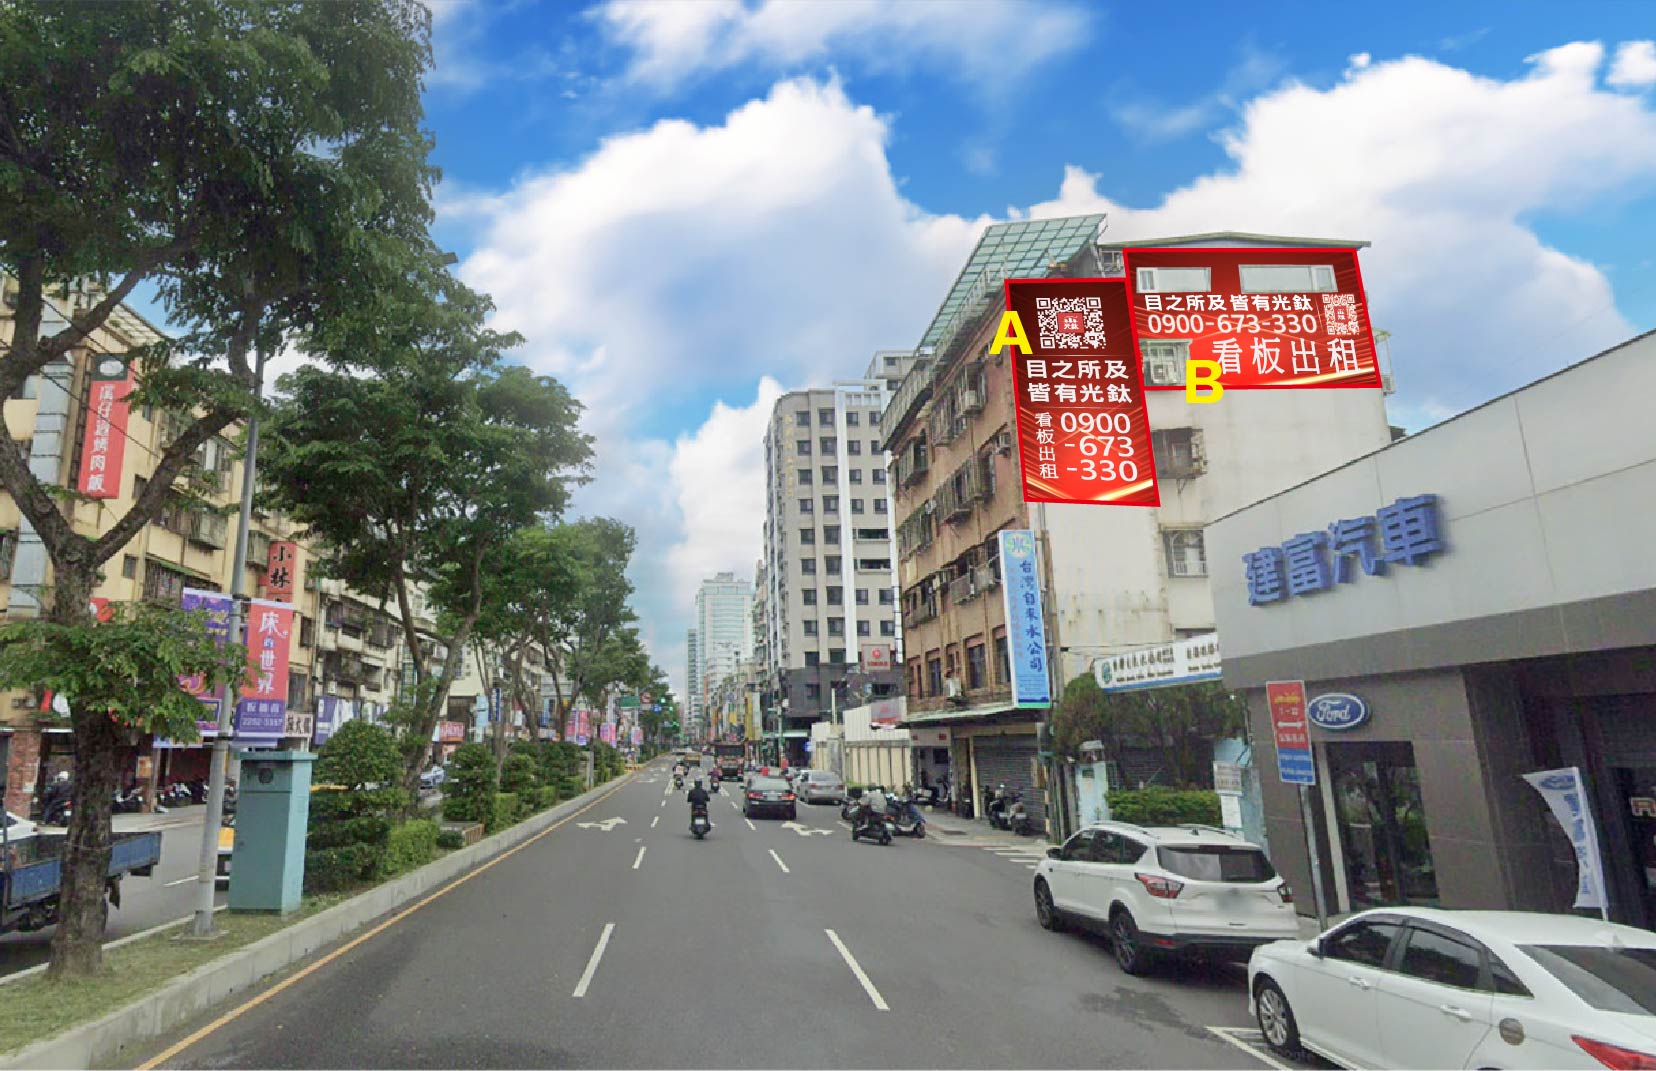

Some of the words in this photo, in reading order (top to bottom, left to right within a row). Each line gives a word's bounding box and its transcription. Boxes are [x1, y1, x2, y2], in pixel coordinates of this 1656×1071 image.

[1145, 295, 1228, 312] 目之所及
[1231, 294, 1314, 312] 皆有光鈦
[1148, 314, 1318, 334] 0900-673-330
[1212, 337, 1361, 376] 看板出租
[1026, 359, 1130, 380] 目之所及
[1027, 383, 1133, 405] 皆有光鈦
[1060, 412, 1131, 434] 0900
[1035, 412, 1059, 479] 看板出租
[1064, 436, 1135, 458] -673
[1067, 459, 1139, 482] -330
[1242, 493, 1443, 607] 建富汽車
[257, 611, 289, 696] 床的世界
[1315, 699, 1352, 723] Ford
